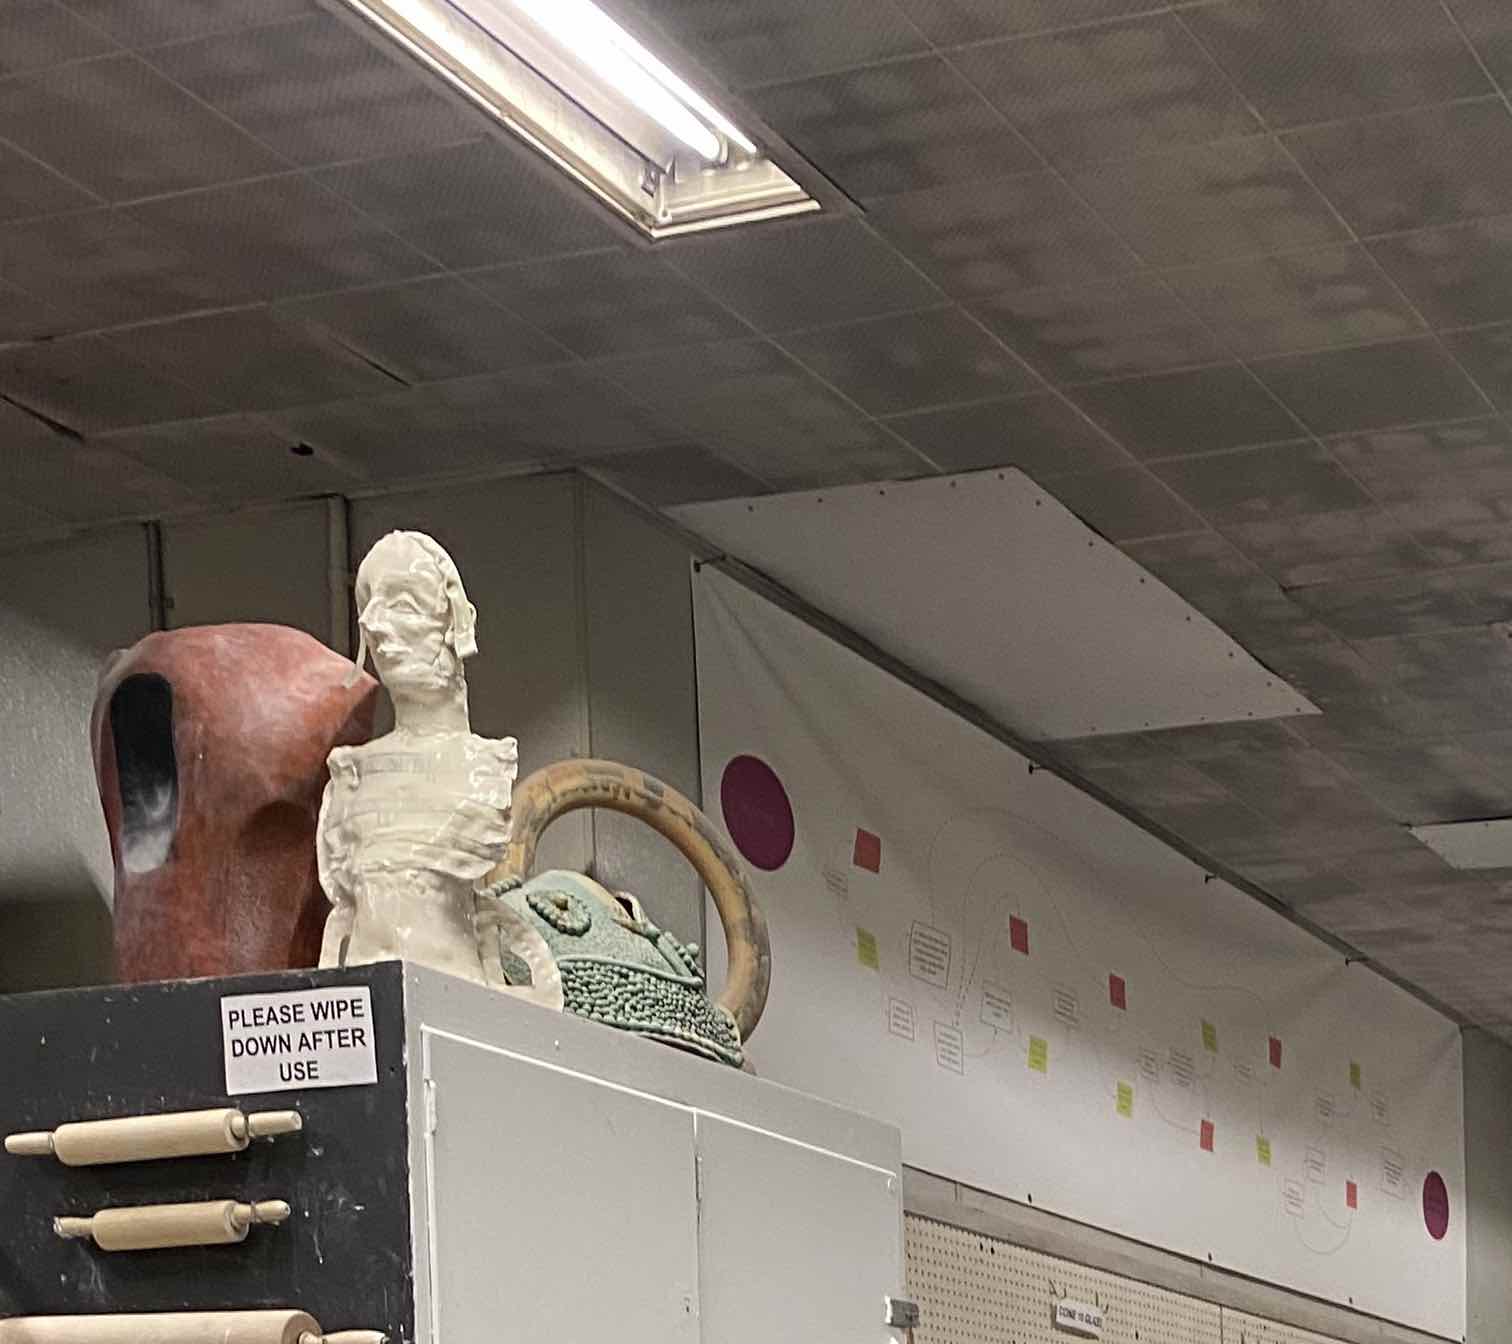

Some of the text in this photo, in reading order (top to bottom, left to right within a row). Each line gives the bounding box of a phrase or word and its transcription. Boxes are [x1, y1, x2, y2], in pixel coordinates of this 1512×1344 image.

[228, 998, 365, 1030] PLEASE WIPE
[231, 1027, 367, 1058] DOWN AFTER
[279, 1060, 320, 1082] USE
